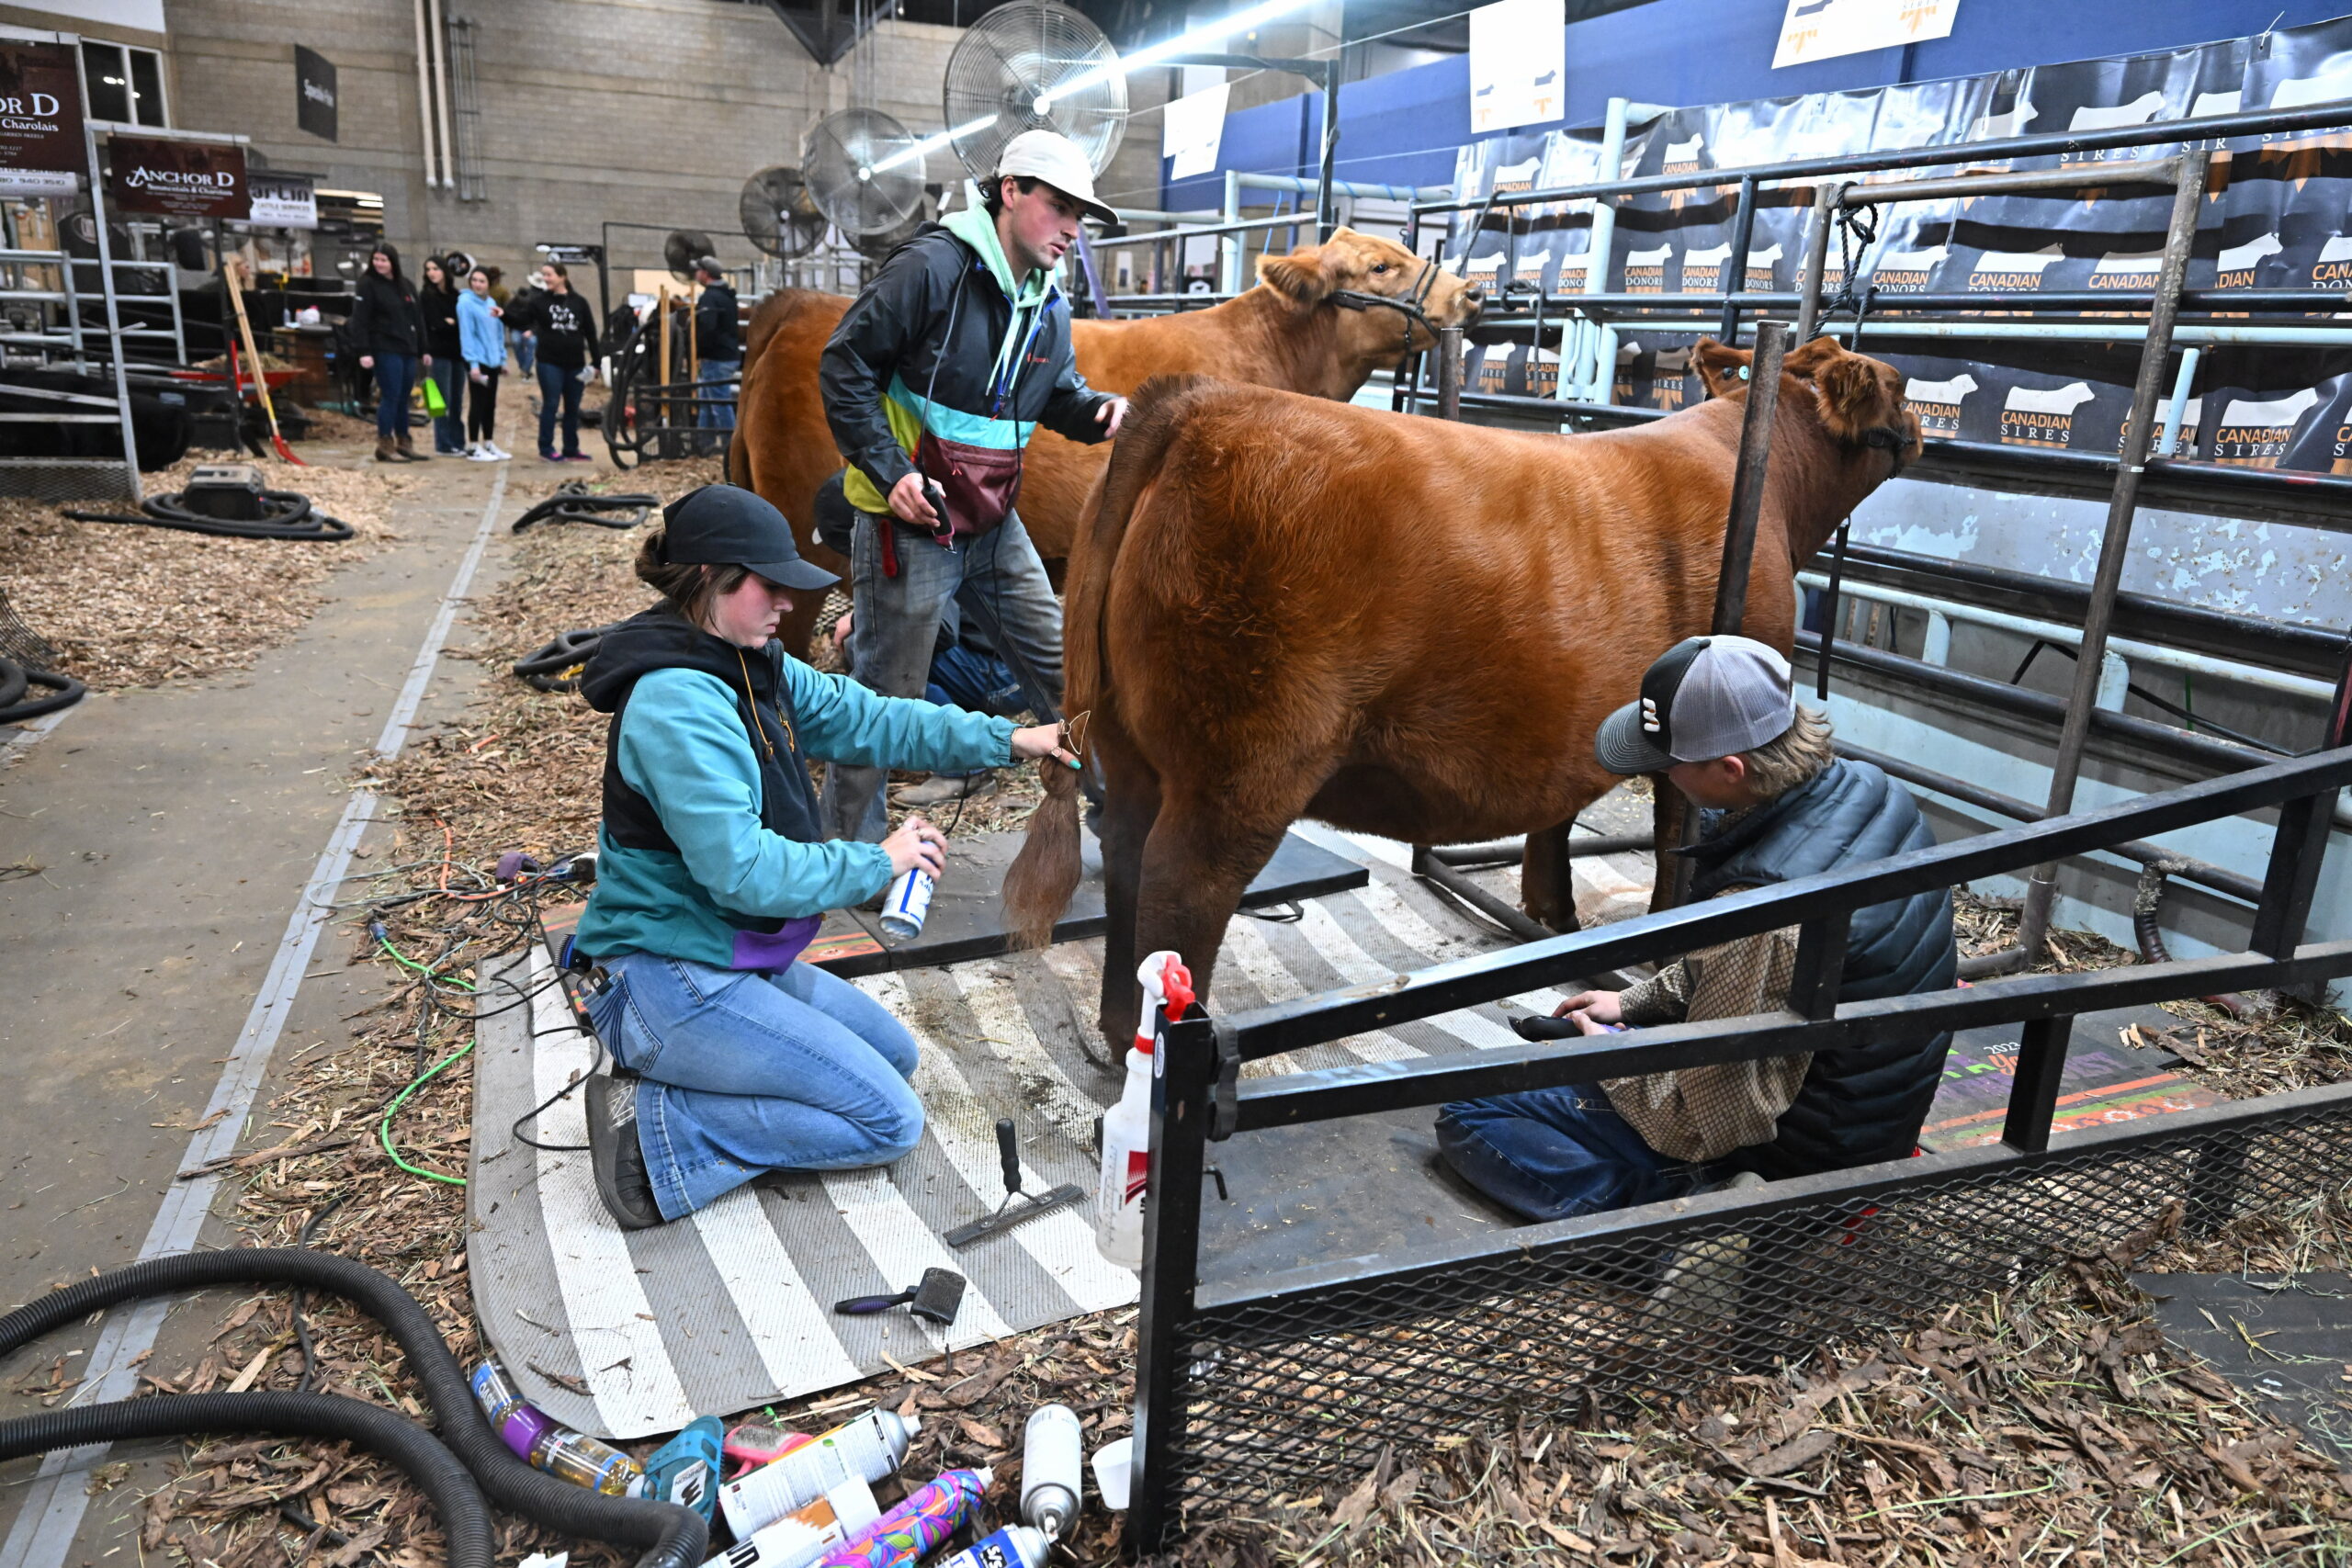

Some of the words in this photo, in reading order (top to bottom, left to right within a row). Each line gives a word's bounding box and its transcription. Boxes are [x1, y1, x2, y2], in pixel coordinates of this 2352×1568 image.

[29, 93, 60, 117] D
[2, 118, 59, 132] Charolais
[1662, 161, 1699, 175] CANADIAN
[216, 172, 235, 187] D
[251, 184, 310, 202] artin
[1682, 267, 1721, 277] CANADIAN
[1872, 271, 1928, 285] CANADIAN
[1625, 276, 1664, 287] DONORS
[1682, 276, 1719, 288] DONORS
[1746, 278, 1773, 290] DONORS
[1969, 273, 2041, 288] CANADIAN
[2001, 411, 2072, 431] CANADIAN
[2000, 423, 2070, 443] SIRES
[2216, 427, 2293, 444] CANADIAN
[2214, 443, 2288, 457] SIRES
[478, 1382, 497, 1413] OASIS
